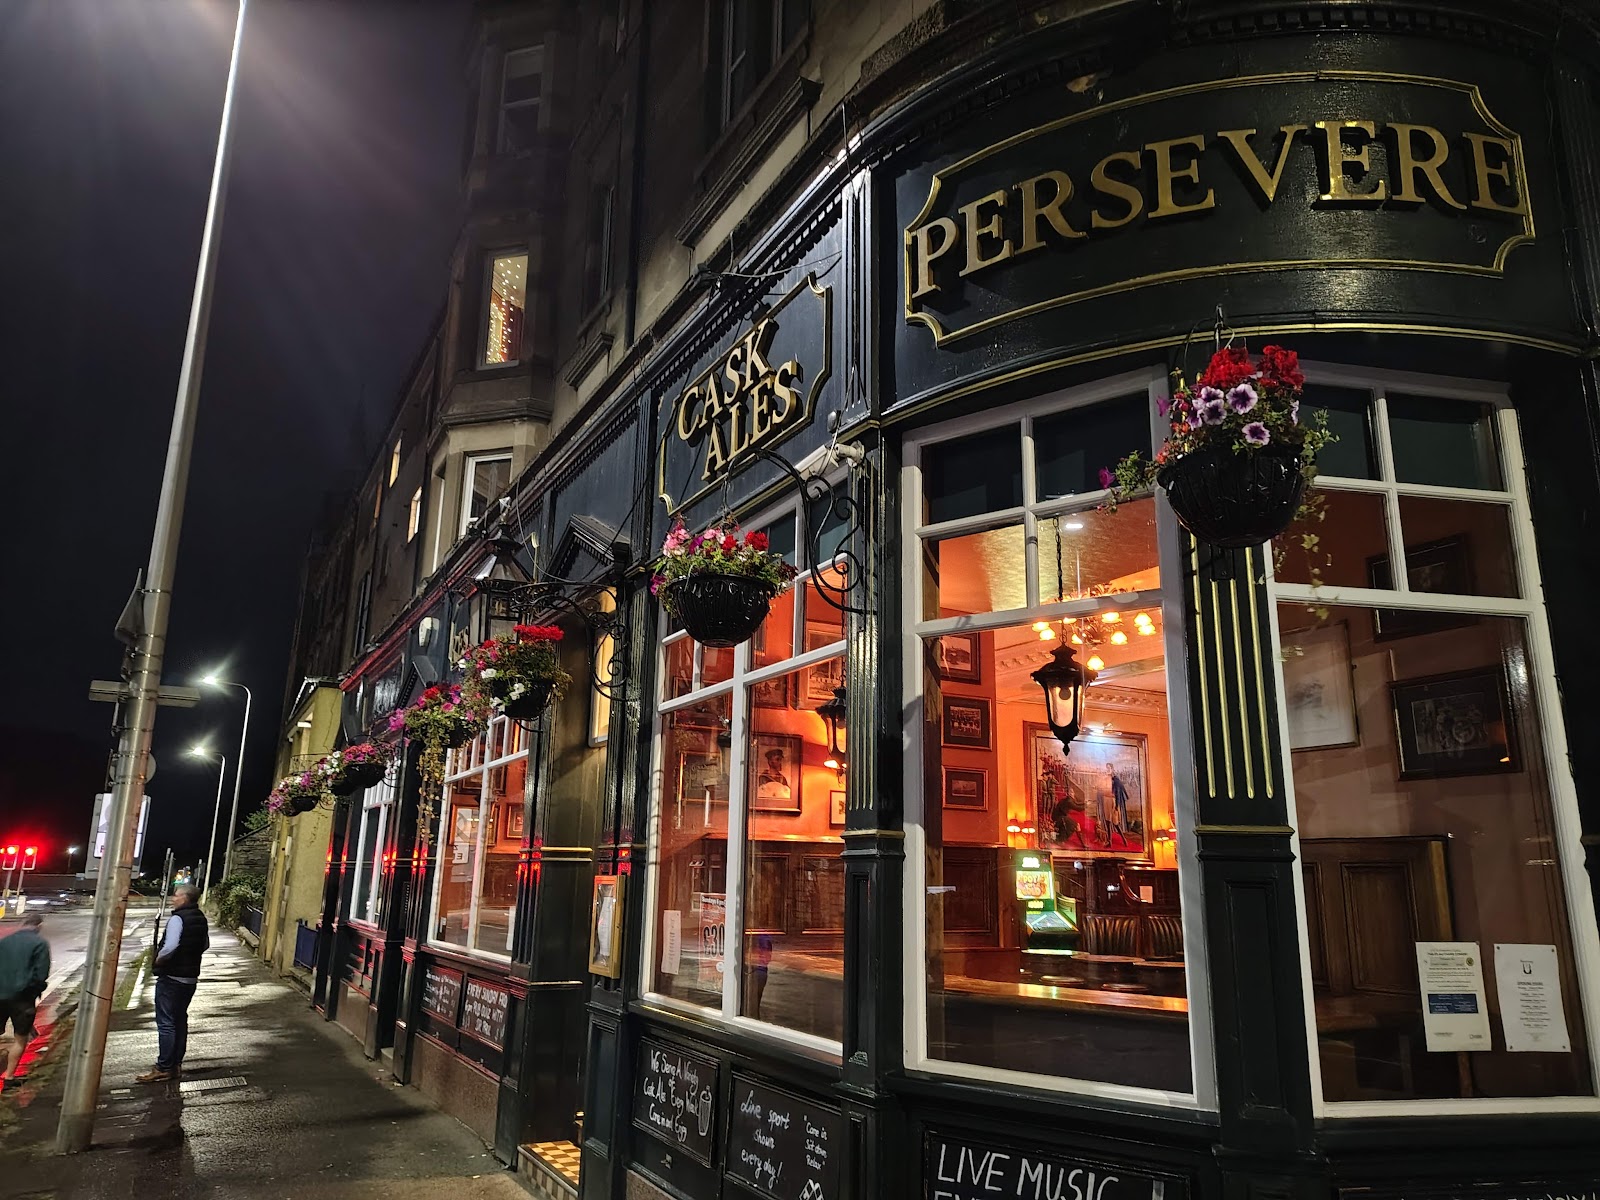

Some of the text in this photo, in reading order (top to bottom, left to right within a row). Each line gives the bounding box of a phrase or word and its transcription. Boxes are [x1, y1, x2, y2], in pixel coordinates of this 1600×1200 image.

[911, 120, 1528, 299] PERSEVERE
[677, 317, 776, 441] CASK
[701, 360, 799, 481] ALES
[650, 1049, 661, 1073] We
[740, 1089, 791, 1132] Live sport
[937, 1142, 1120, 1200] LIVE MUSIC
